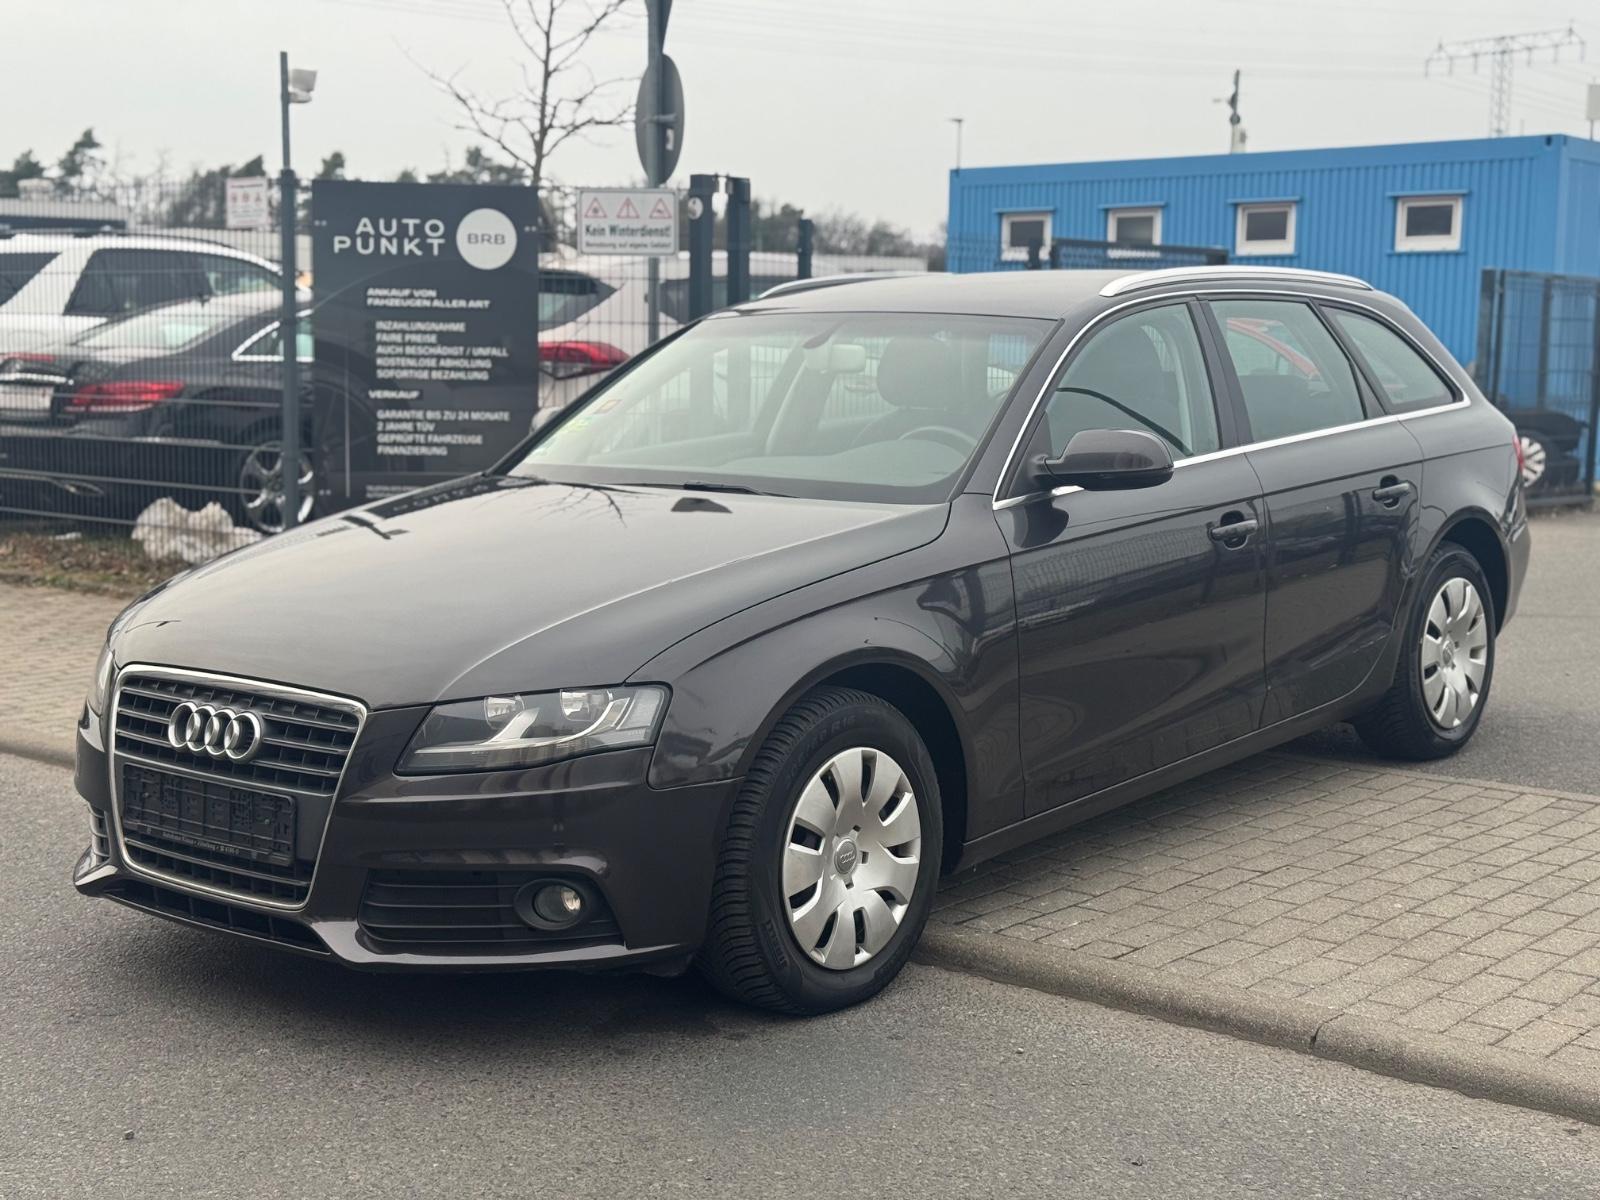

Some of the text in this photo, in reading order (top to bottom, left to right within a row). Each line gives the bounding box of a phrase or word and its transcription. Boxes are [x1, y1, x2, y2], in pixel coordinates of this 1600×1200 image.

[355, 217, 445, 237] AUTO
[585, 225, 605, 236] Kein
[467, 232, 506, 246] BRB
[333, 235, 445, 257] PUNKT
[366, 287, 437, 298] ANKAUF VON
[432, 299, 467, 309] ALLER
[467, 299, 491, 309] ART
[375, 320, 466, 332] INZAHLUNGNAHME
[375, 332, 438, 344] FAIRE PREISE
[376, 345, 404, 355] AUCH
[404, 344, 464, 356] BESCHÄDIGT
[471, 347, 509, 357] UNFALL
[376, 357, 492, 369] KOSTENLOSE ABHOLUNG
[376, 369, 489, 381] SOFORTIGE BEZAHLUNG
[368, 389, 420, 399] VERKAUF
[376, 409, 510, 421] GARANTIE BIS ZU 24 MONATE
[384, 421, 415, 431] JAHRE
[416, 421, 436, 432] TÜV
[376, 432, 483, 445] GEPRÜFTE FAHRZEUGE
[376, 445, 448, 456] FINANZIERUNG
